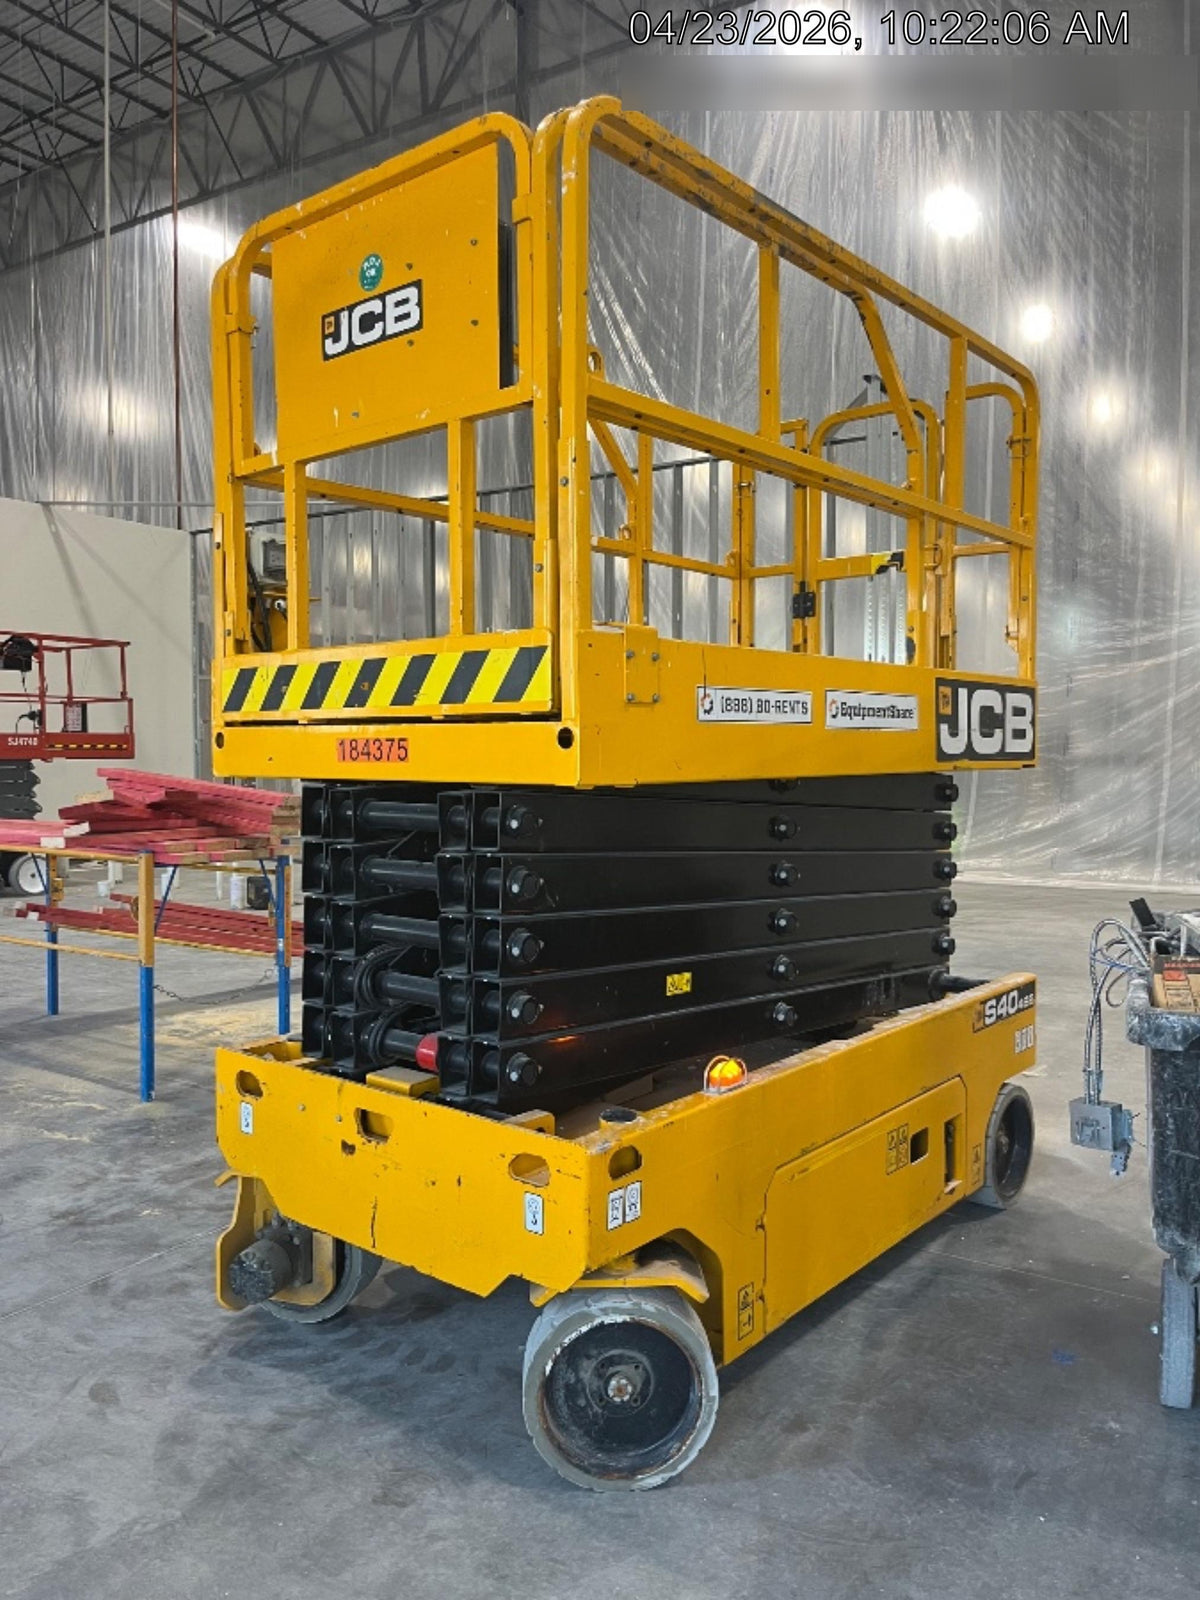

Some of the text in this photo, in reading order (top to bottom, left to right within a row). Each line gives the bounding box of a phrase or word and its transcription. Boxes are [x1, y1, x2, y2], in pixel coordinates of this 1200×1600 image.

[325, 286, 420, 355] JCB
[339, 738, 408, 761] 184375
[940, 688, 1034, 754] JCB
